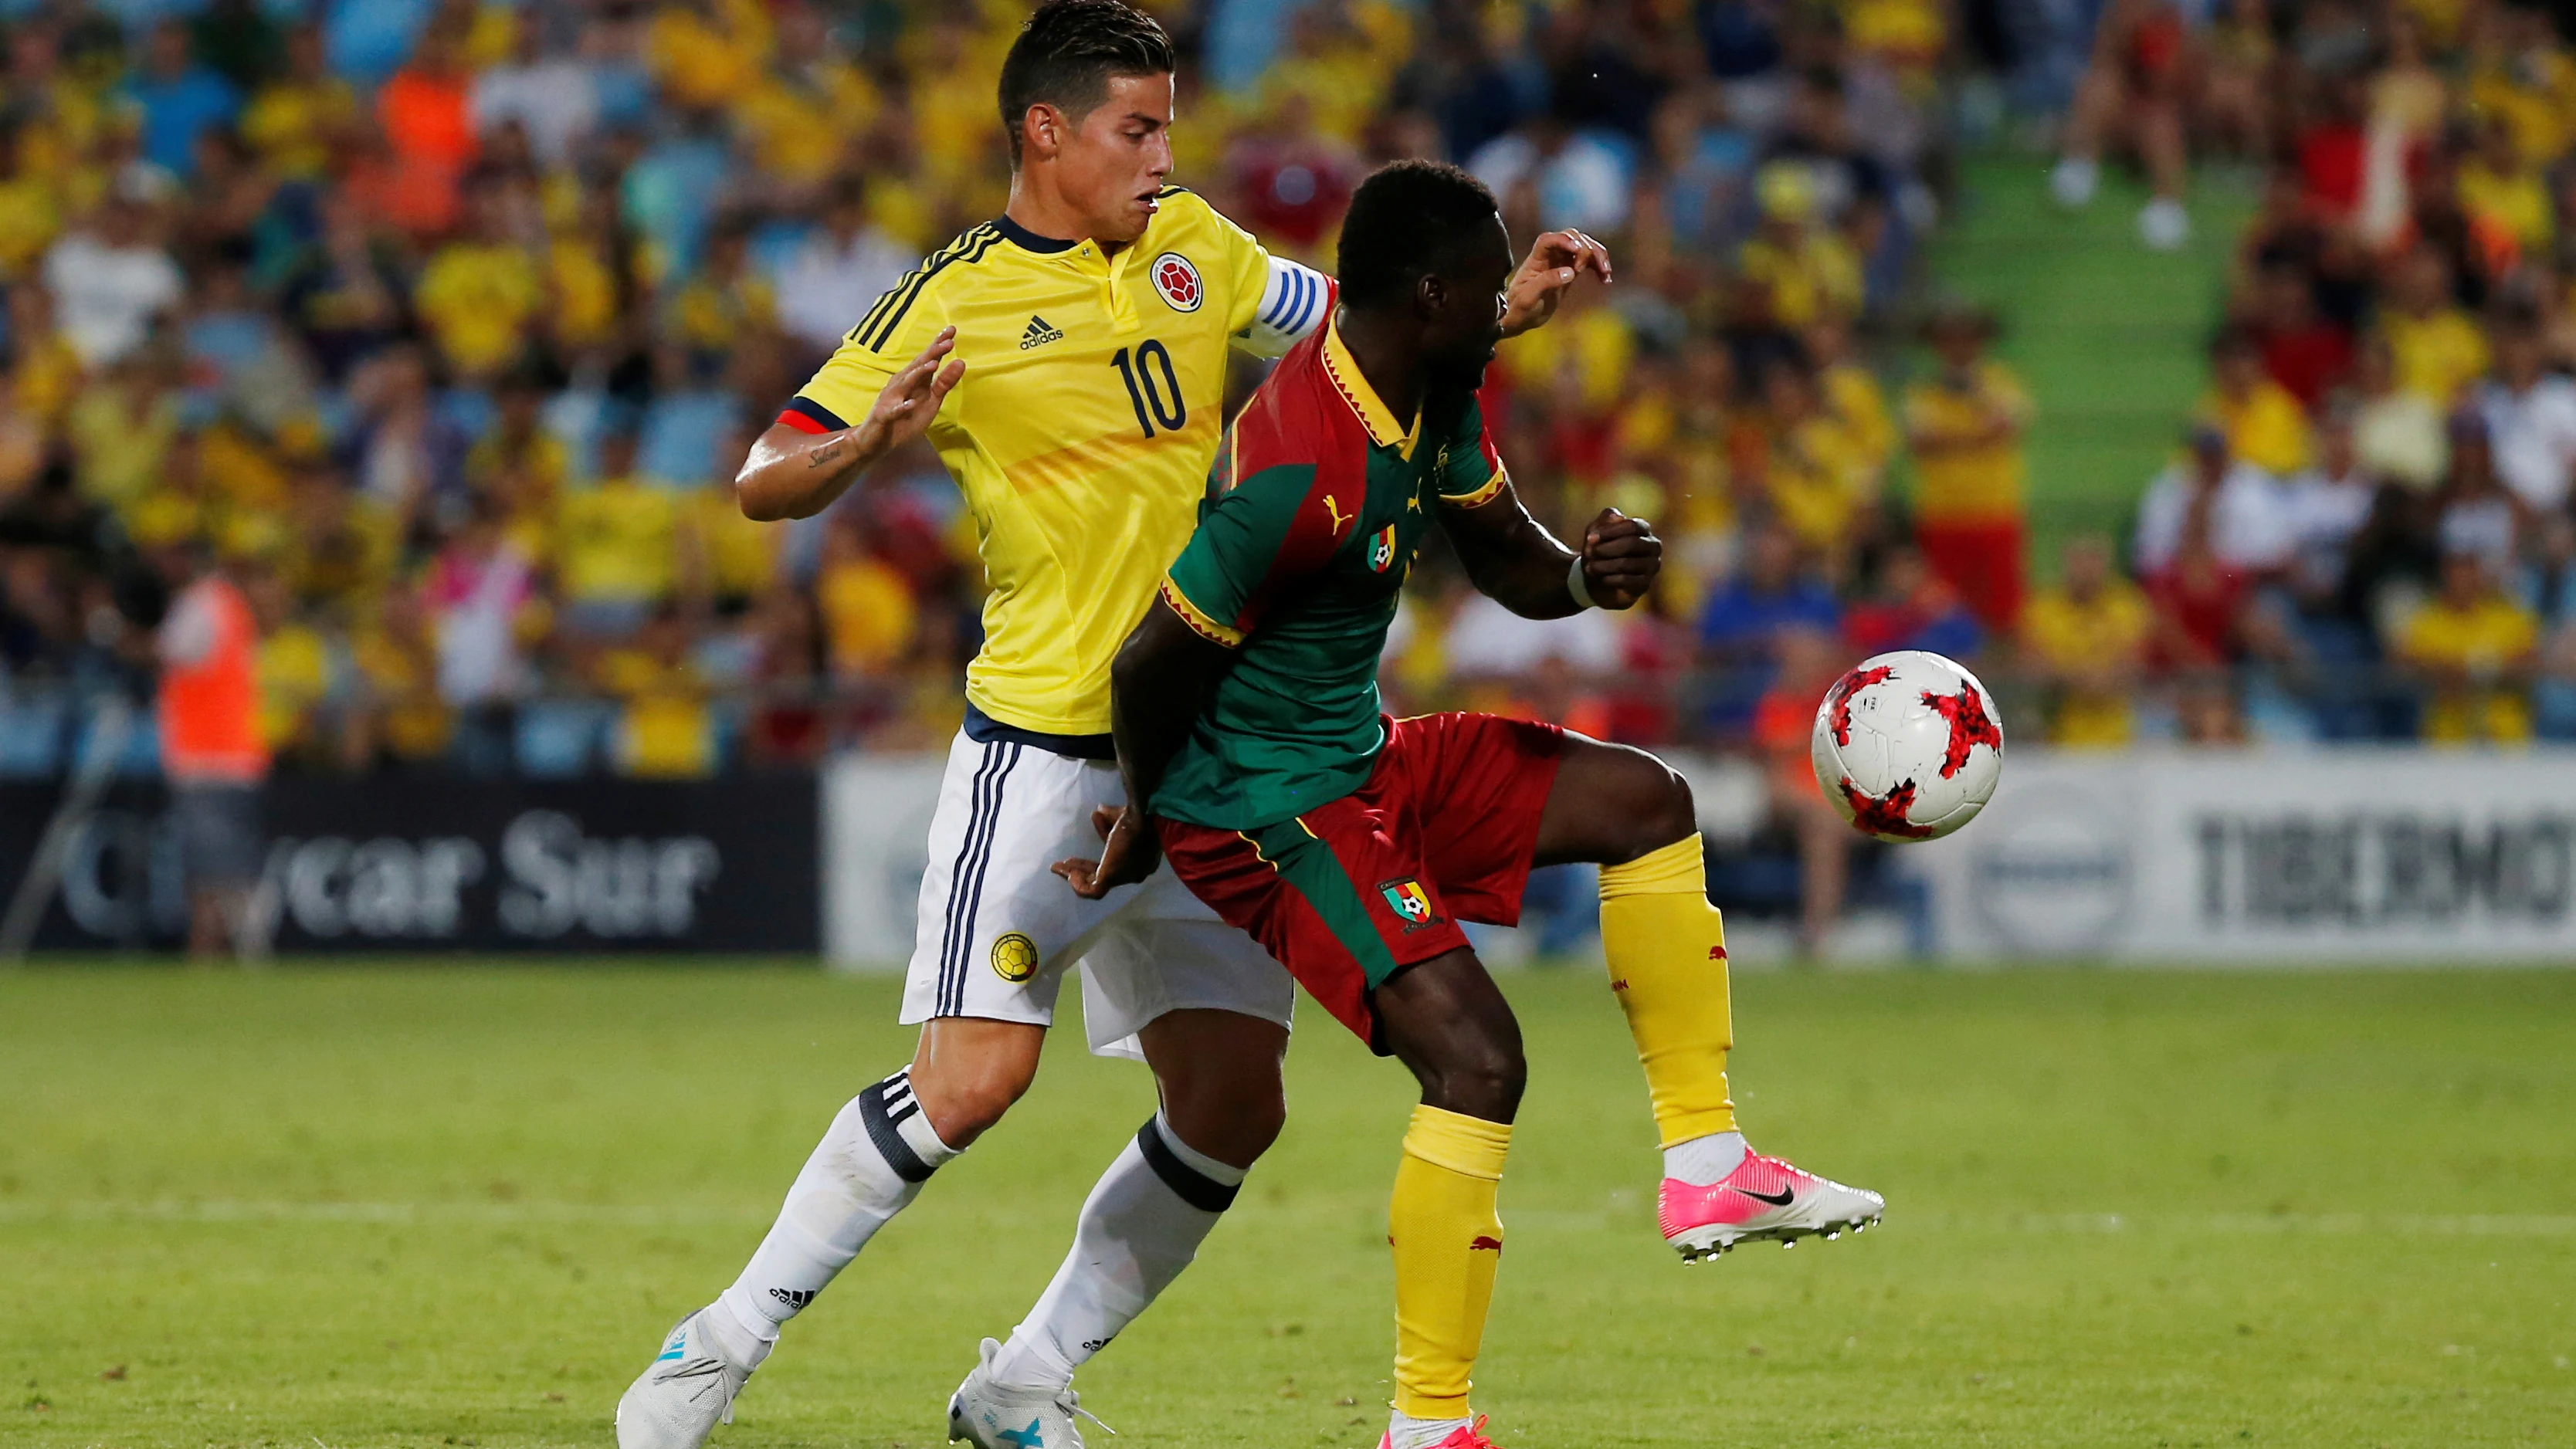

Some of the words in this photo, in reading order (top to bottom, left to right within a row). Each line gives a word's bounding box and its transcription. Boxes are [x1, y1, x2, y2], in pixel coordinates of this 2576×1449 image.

[1020, 330, 1063, 350] adidas
[1110, 338, 1187, 439] 10
[497, 809, 721, 936] Sur
